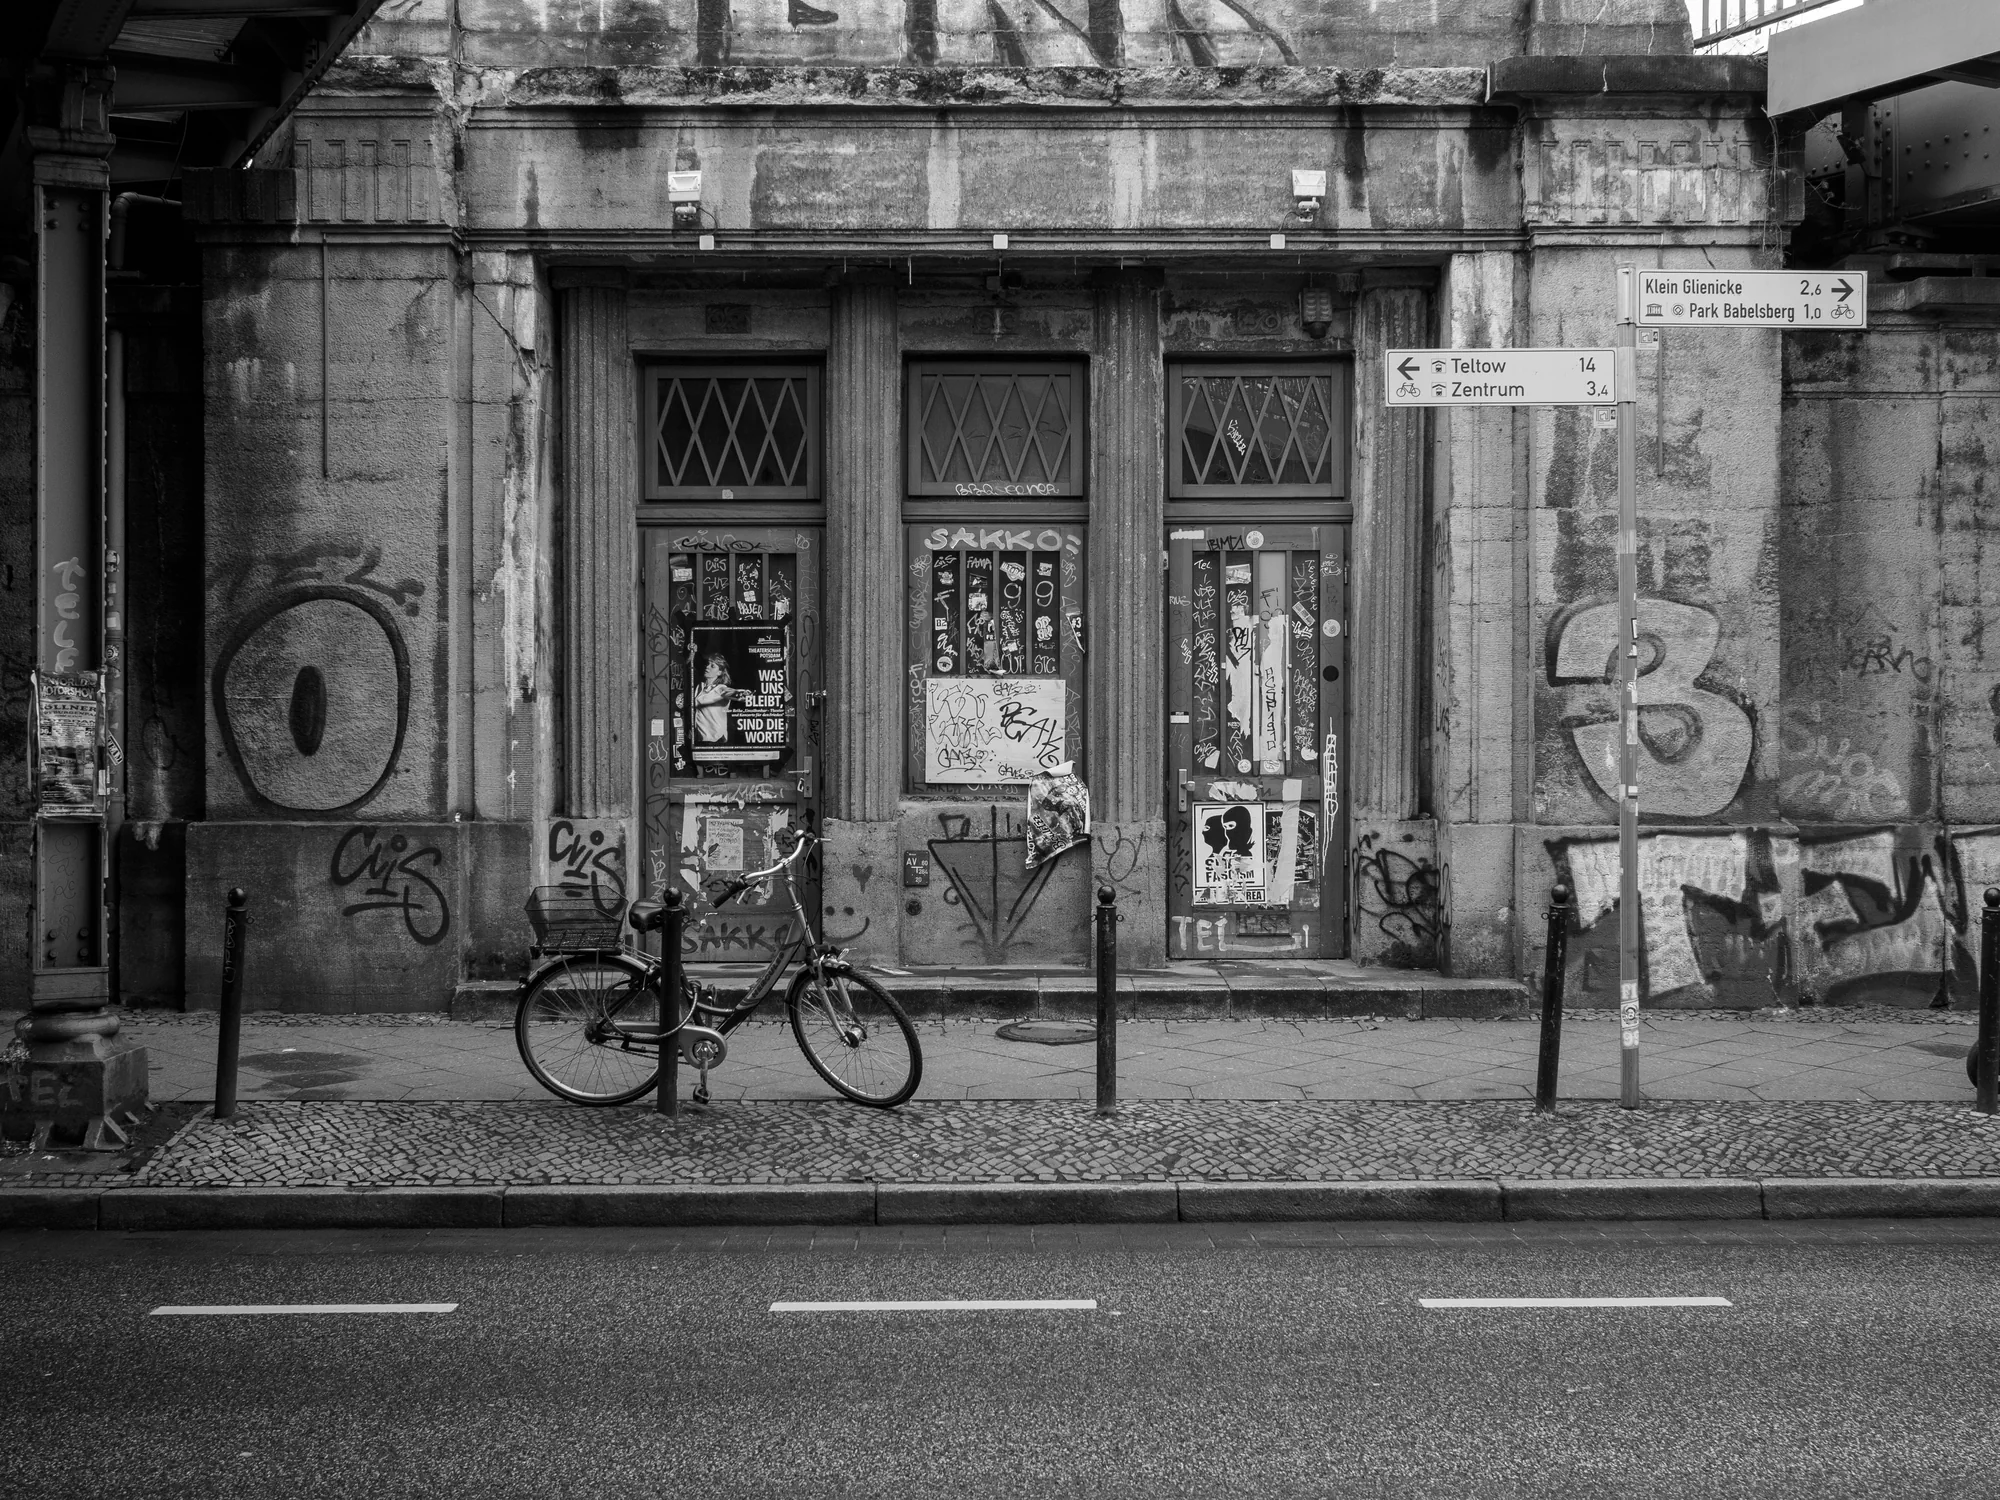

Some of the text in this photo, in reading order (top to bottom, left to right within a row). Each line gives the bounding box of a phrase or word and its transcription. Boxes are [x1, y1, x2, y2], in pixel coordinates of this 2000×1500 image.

[1645, 278, 1822, 297] Klein Glienicke 2,6
[1689, 303, 1822, 322] Park Babelsberg 1,0
[1450, 357, 1596, 374] Teltow 14
[1451, 381, 1608, 398] Zentrum 3,4
[923, 528, 1061, 551] SAKKO
[758, 669, 784, 682] WAS
[761, 682, 784, 695] UNS
[745, 695, 784, 709] BLEIBT,
[737, 718, 785, 731] SIND DIE
[745, 731, 785, 744] WORTE
